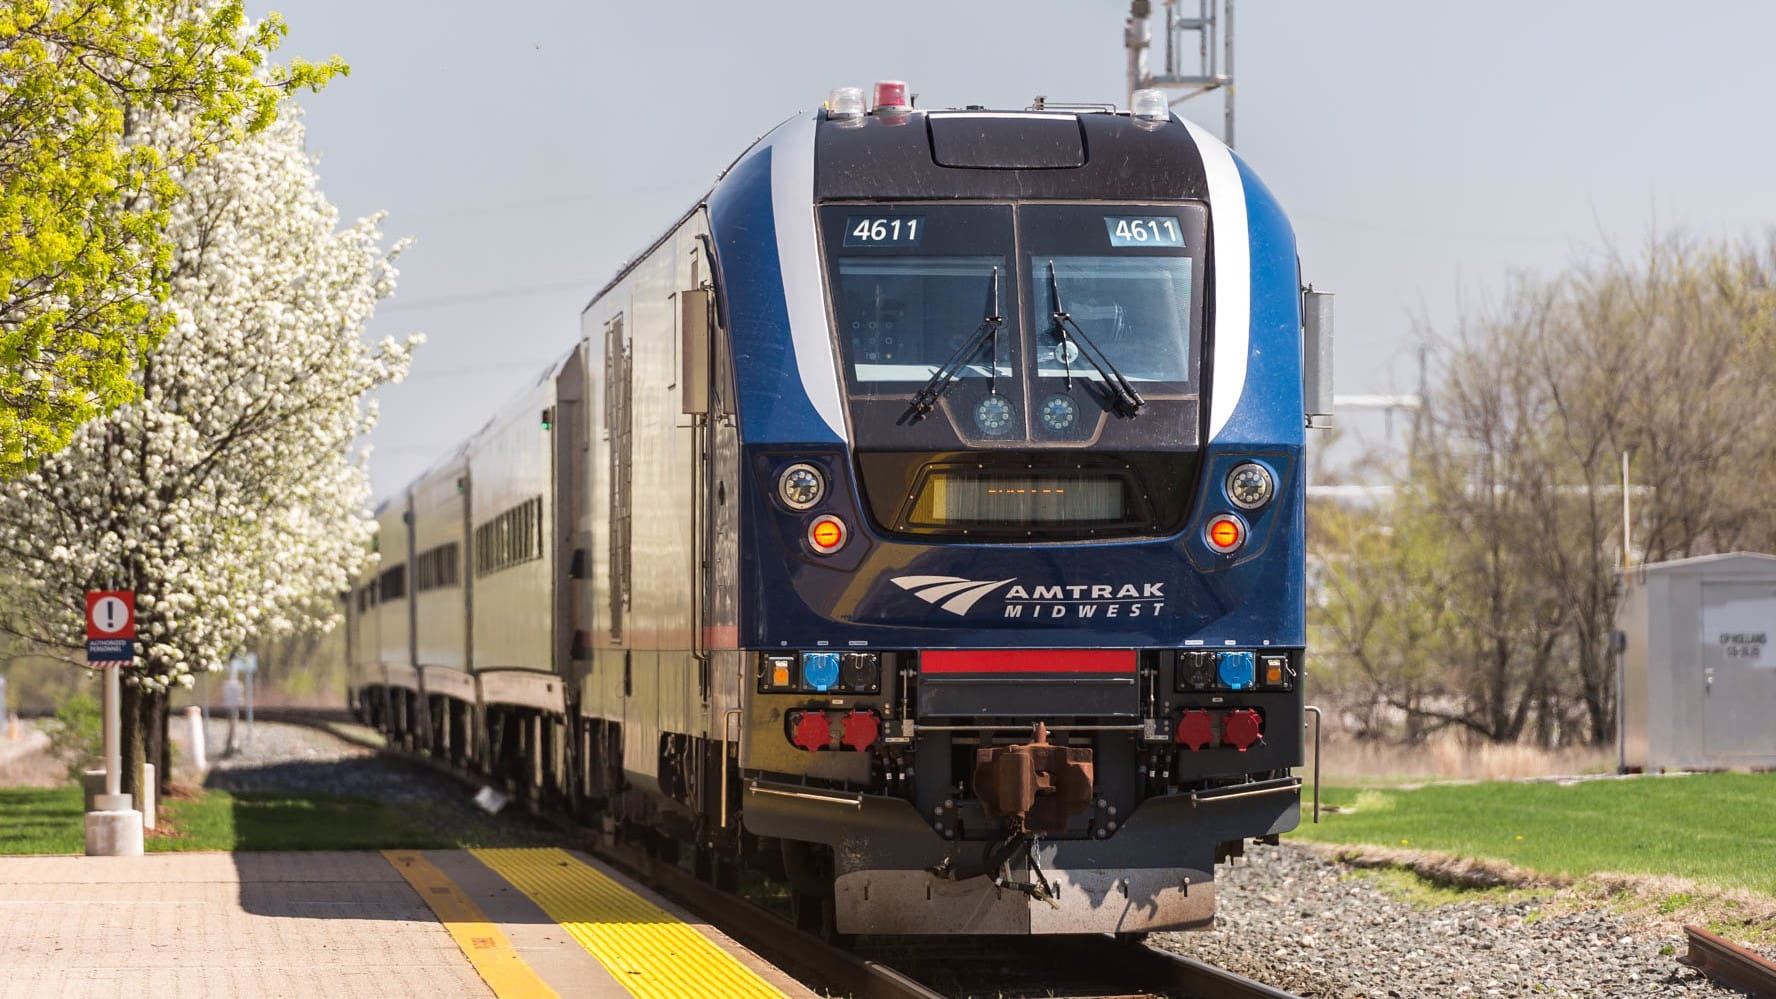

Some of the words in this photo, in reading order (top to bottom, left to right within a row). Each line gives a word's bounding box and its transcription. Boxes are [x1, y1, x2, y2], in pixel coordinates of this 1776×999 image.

[853, 219, 917, 240] 4611
[1115, 219, 1177, 242] 4611
[1005, 582, 1165, 599] AMTRAK
[1003, 603, 1164, 618] MIDWEST
